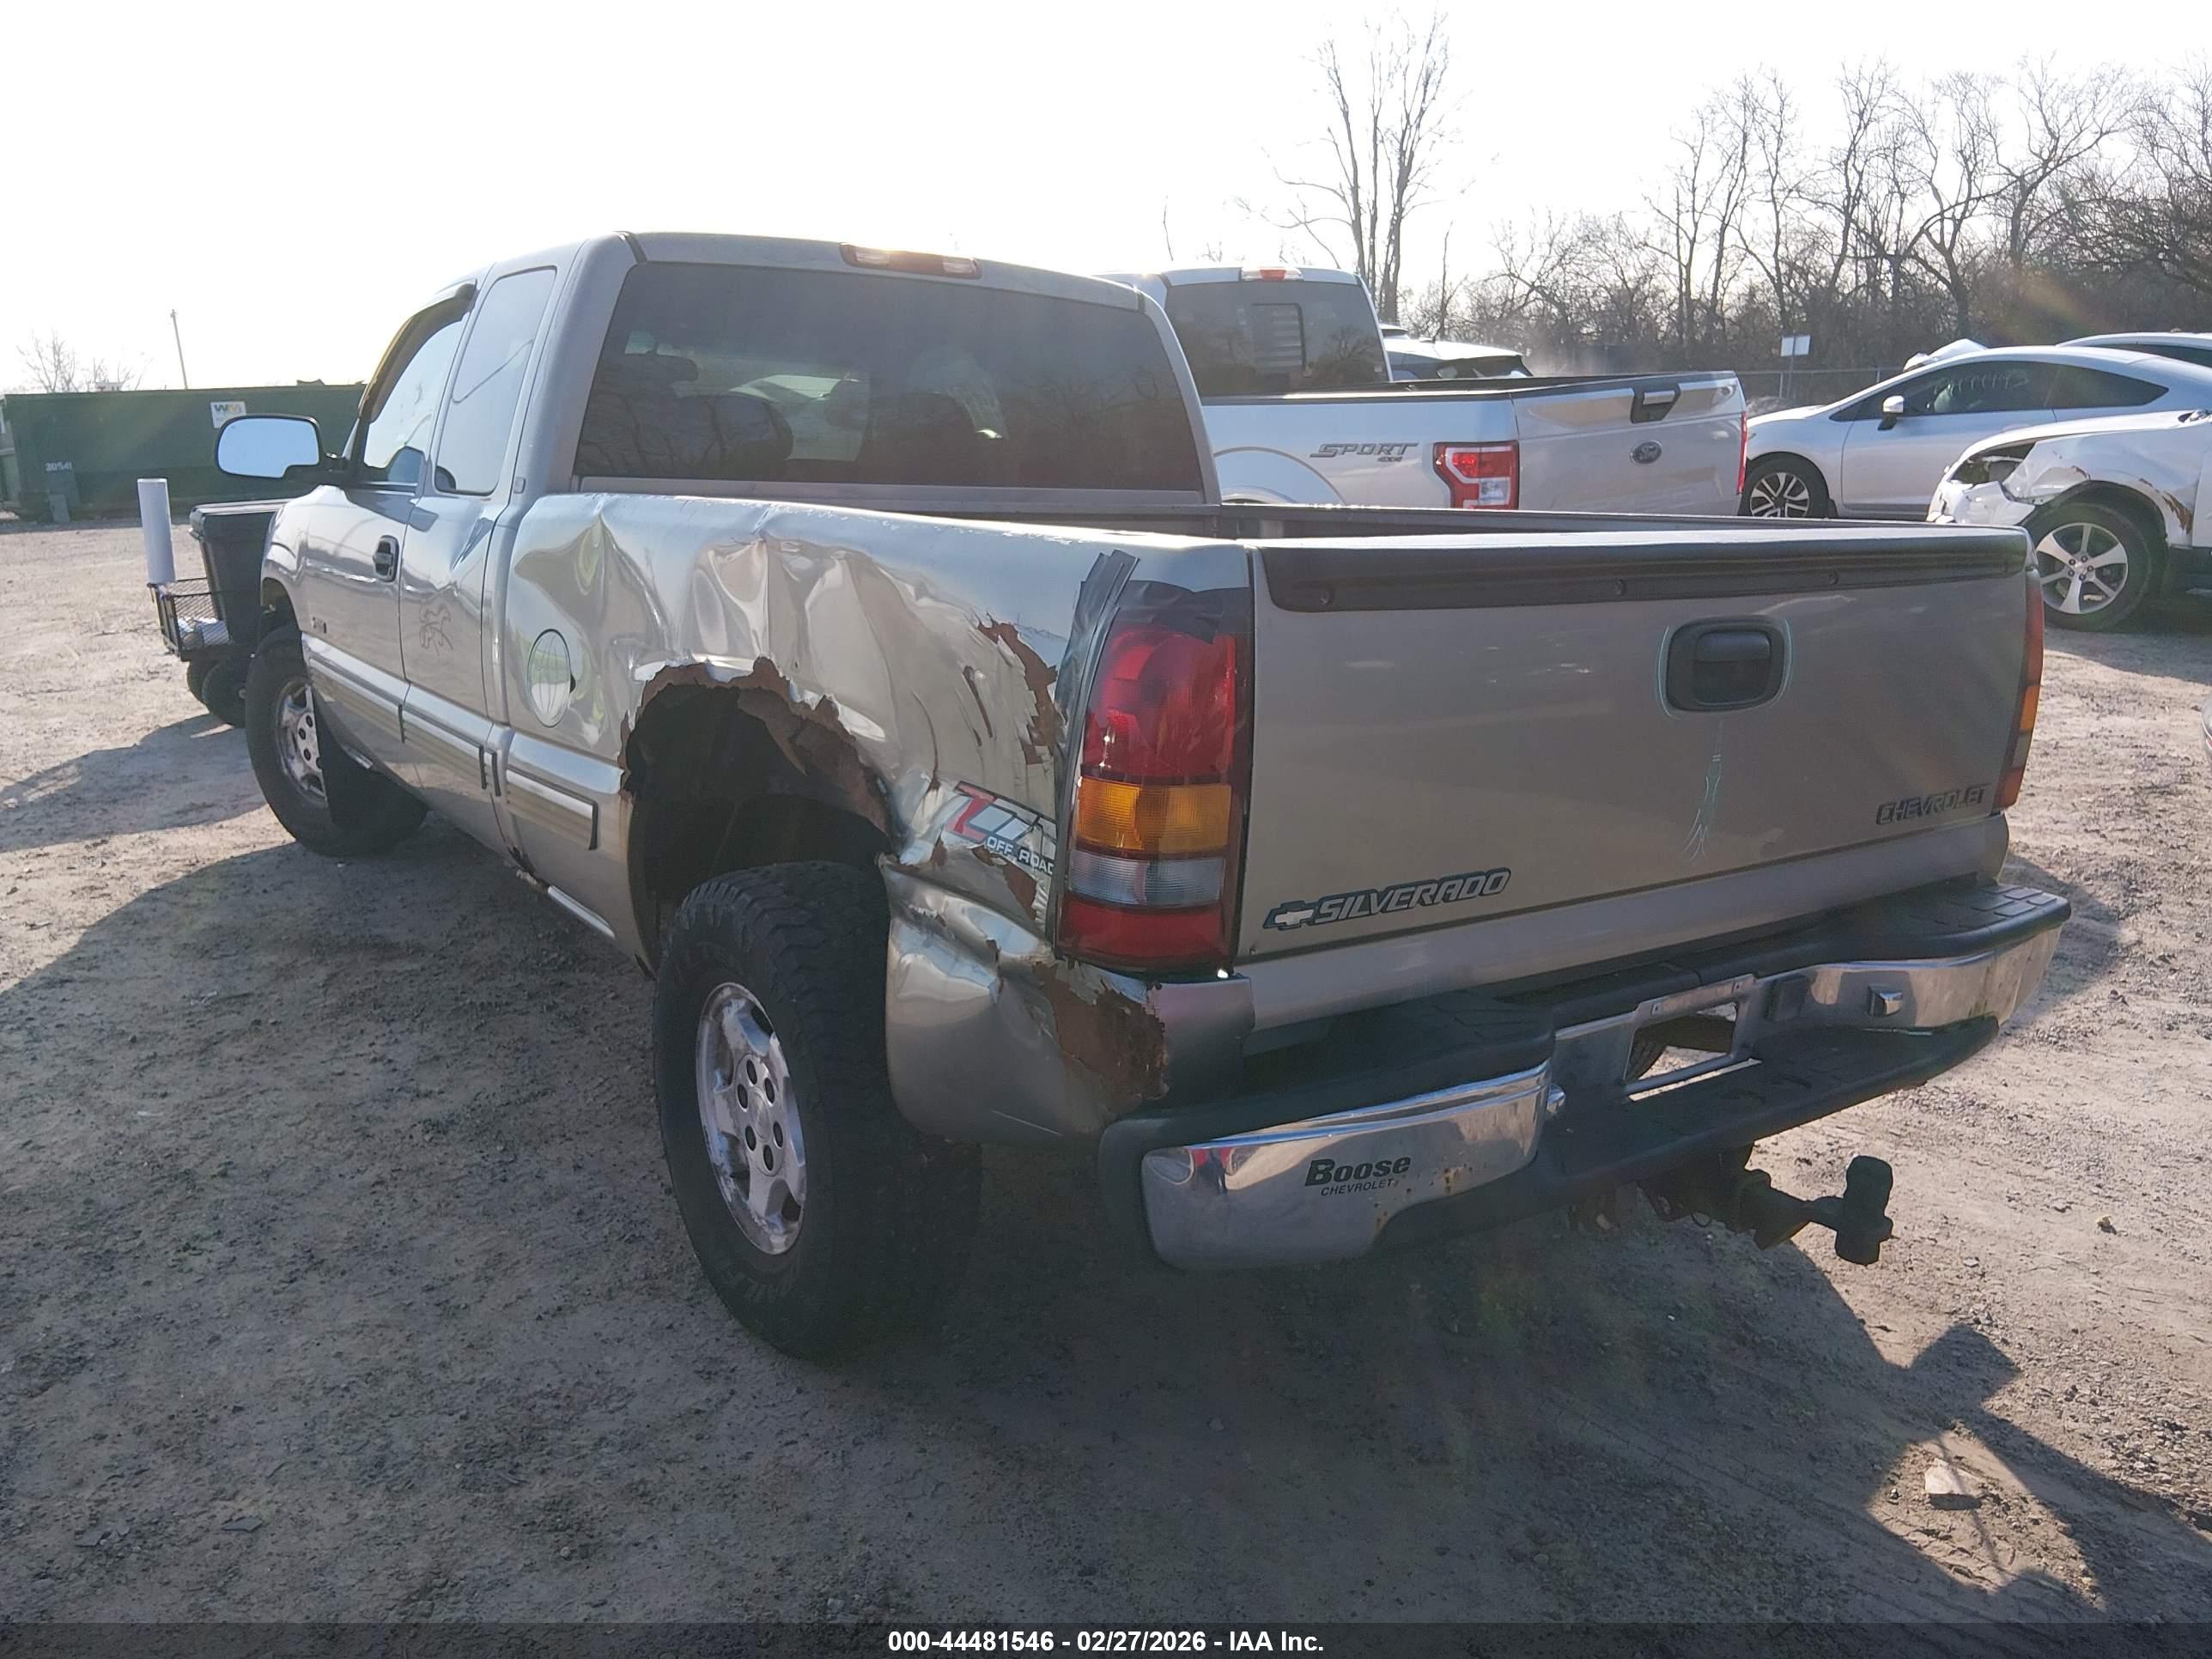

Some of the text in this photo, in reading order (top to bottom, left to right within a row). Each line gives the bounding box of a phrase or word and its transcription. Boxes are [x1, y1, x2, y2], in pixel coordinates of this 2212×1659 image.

[1310, 442, 1419, 458] SPORT
[1875, 783, 1992, 824] CHEVROLET
[986, 836, 1014, 855] OFF
[1313, 867, 1511, 924] SILVERADO
[1304, 1156, 1412, 1187] Boose
[1321, 1178, 1394, 1196] CHEVROLET
